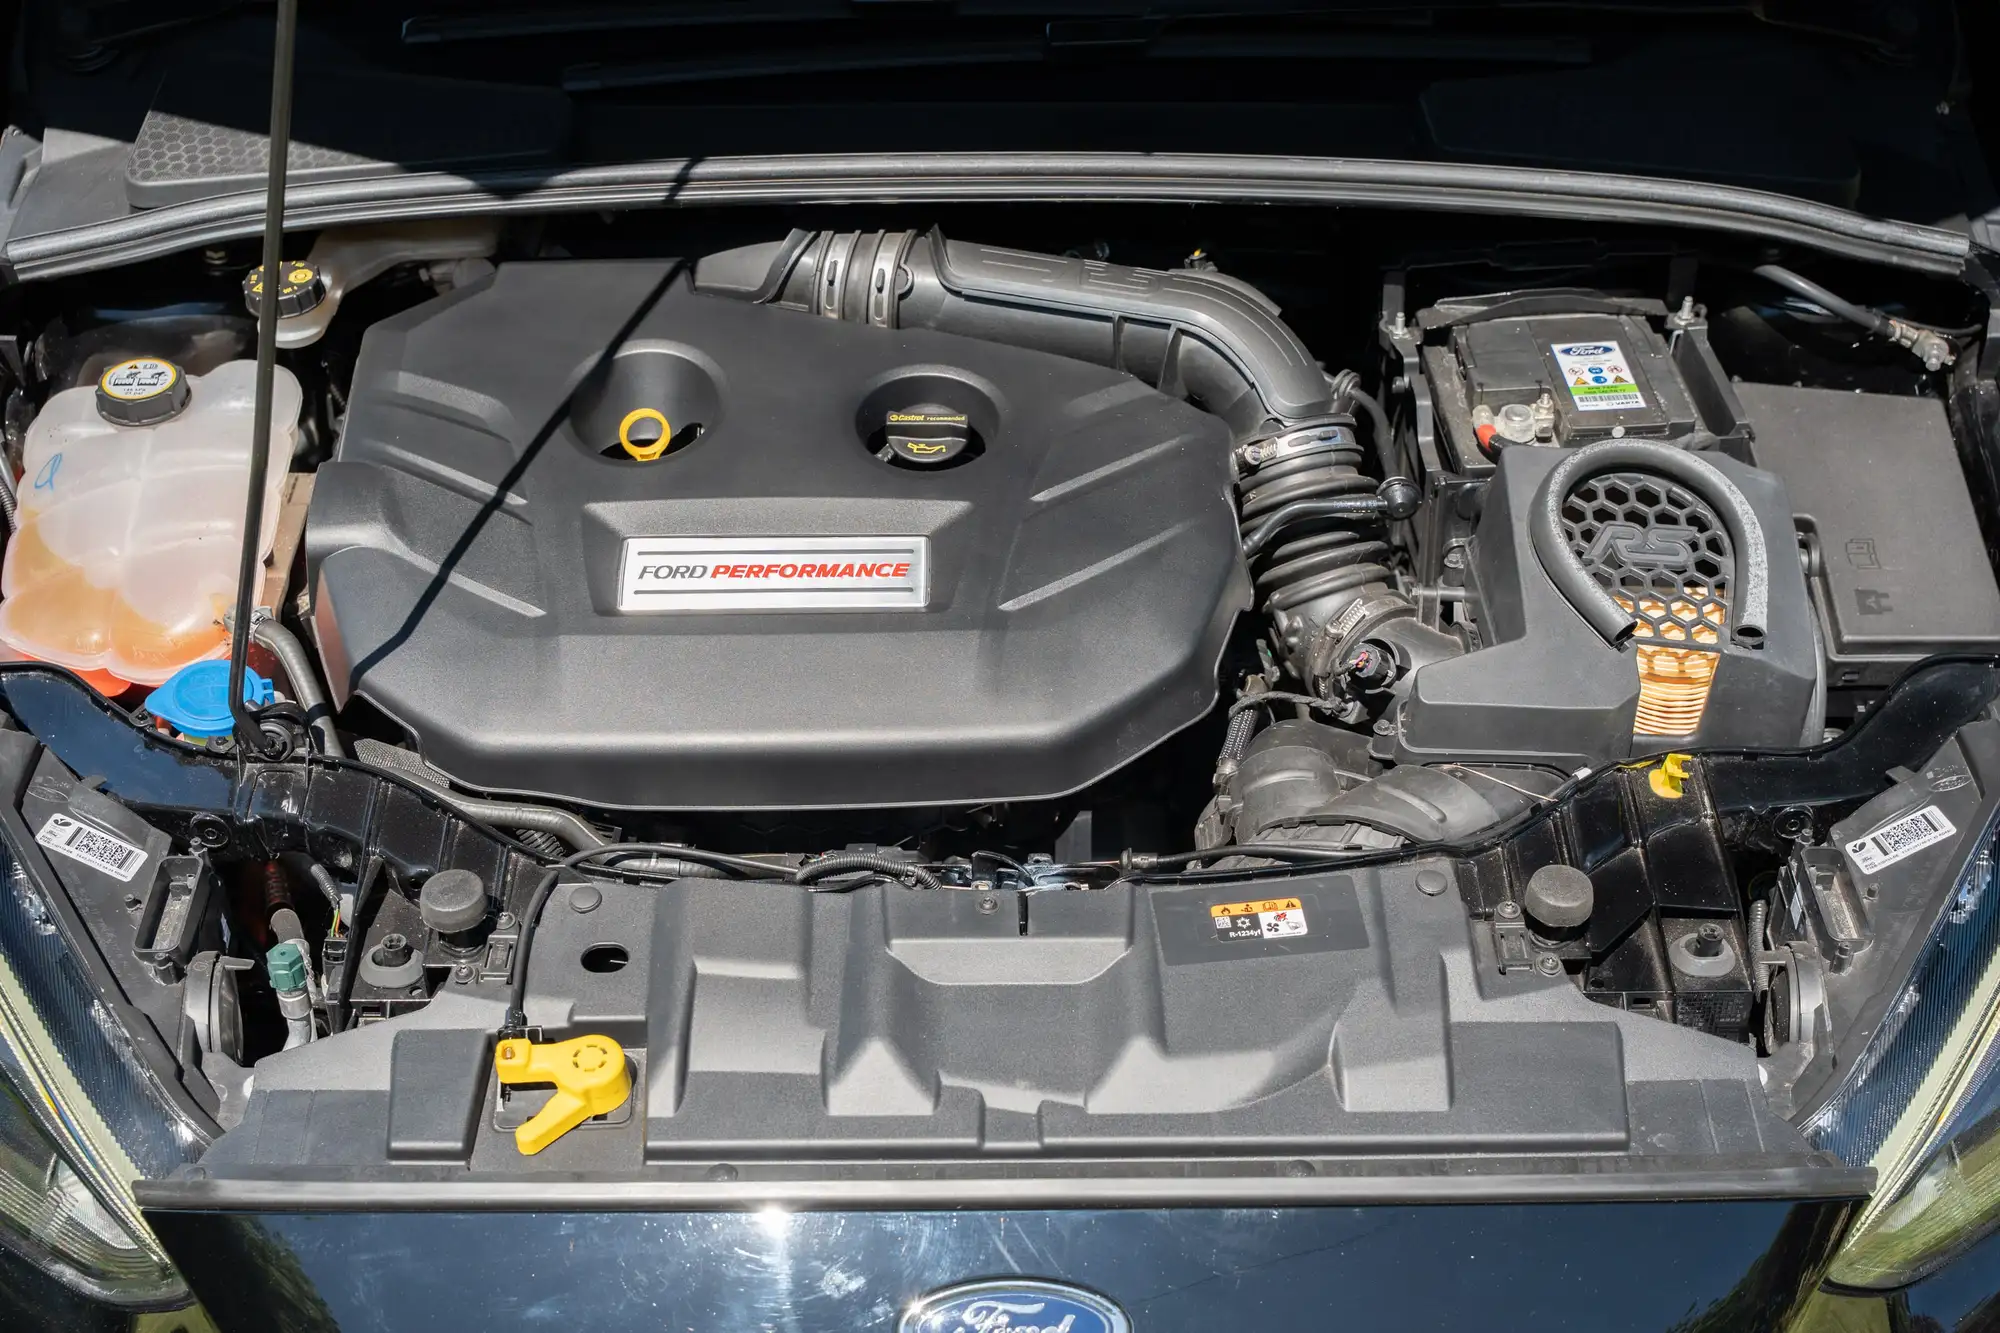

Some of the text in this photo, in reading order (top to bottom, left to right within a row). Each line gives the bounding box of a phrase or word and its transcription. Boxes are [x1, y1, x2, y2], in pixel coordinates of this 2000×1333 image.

[898, 414, 925, 422] Castrol
[1582, 521, 1698, 570] RS
[637, 562, 911, 580] FORD PERFORMANCE
[1229, 928, 1263, 939] R-1234yf
